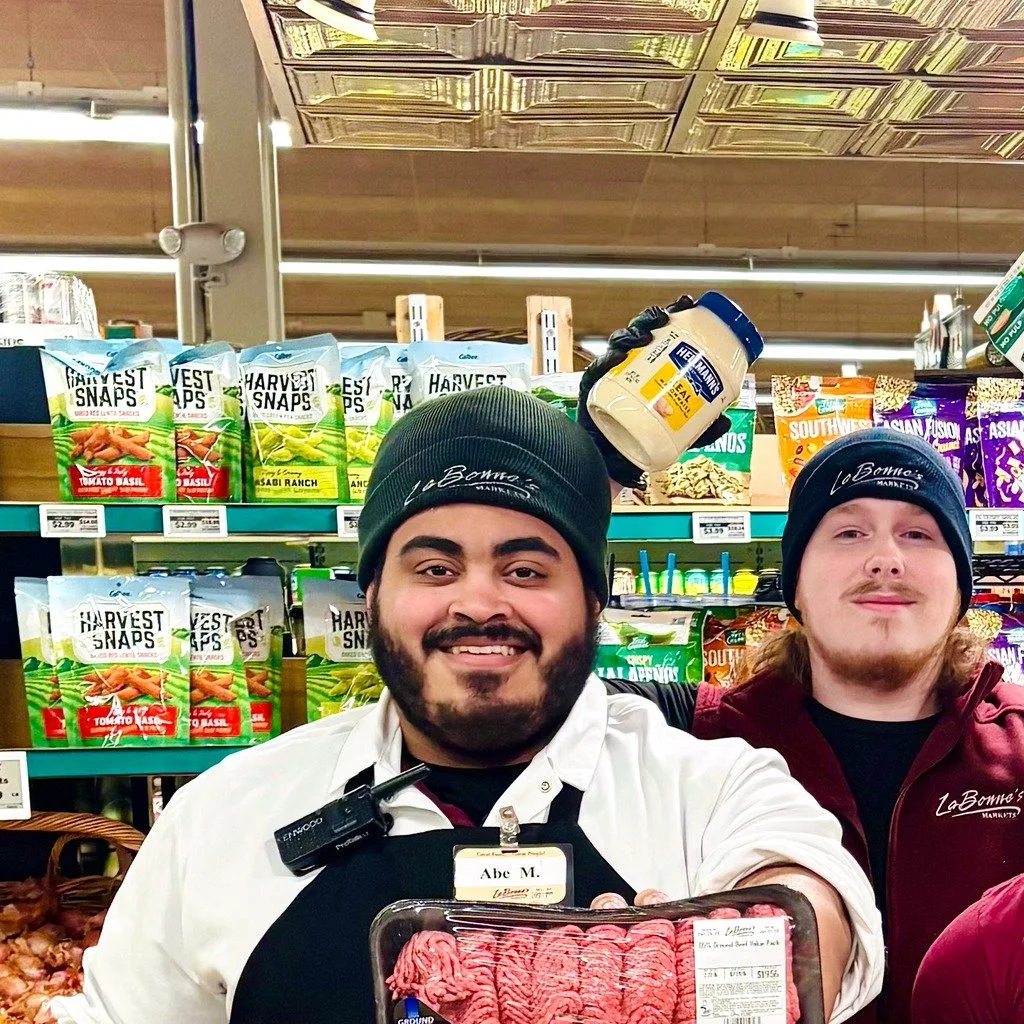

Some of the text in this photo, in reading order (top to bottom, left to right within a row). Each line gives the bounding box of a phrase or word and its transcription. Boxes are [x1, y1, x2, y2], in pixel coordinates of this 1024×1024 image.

[1000, 320, 1022, 349] NO PULP
[170, 368, 213, 391] VEST
[675, 346, 720, 396] HELMANN'S
[75, 387, 137, 407] SNAPS
[252, 391, 311, 412] SNAPS
[79, 477, 145, 487] TOMATO BASIL
[284, 478, 317, 487] RANCH
[52, 520, 75, 528] $2.99
[80, 610, 163, 633] HARVEST
[190, 612, 233, 633] VEST
[92, 630, 154, 649] SNAPS
[935, 788, 1024, 817] LaBonne's
[277, 817, 323, 842] ENWOOD
[480, 866, 540, 880] Abe M.
